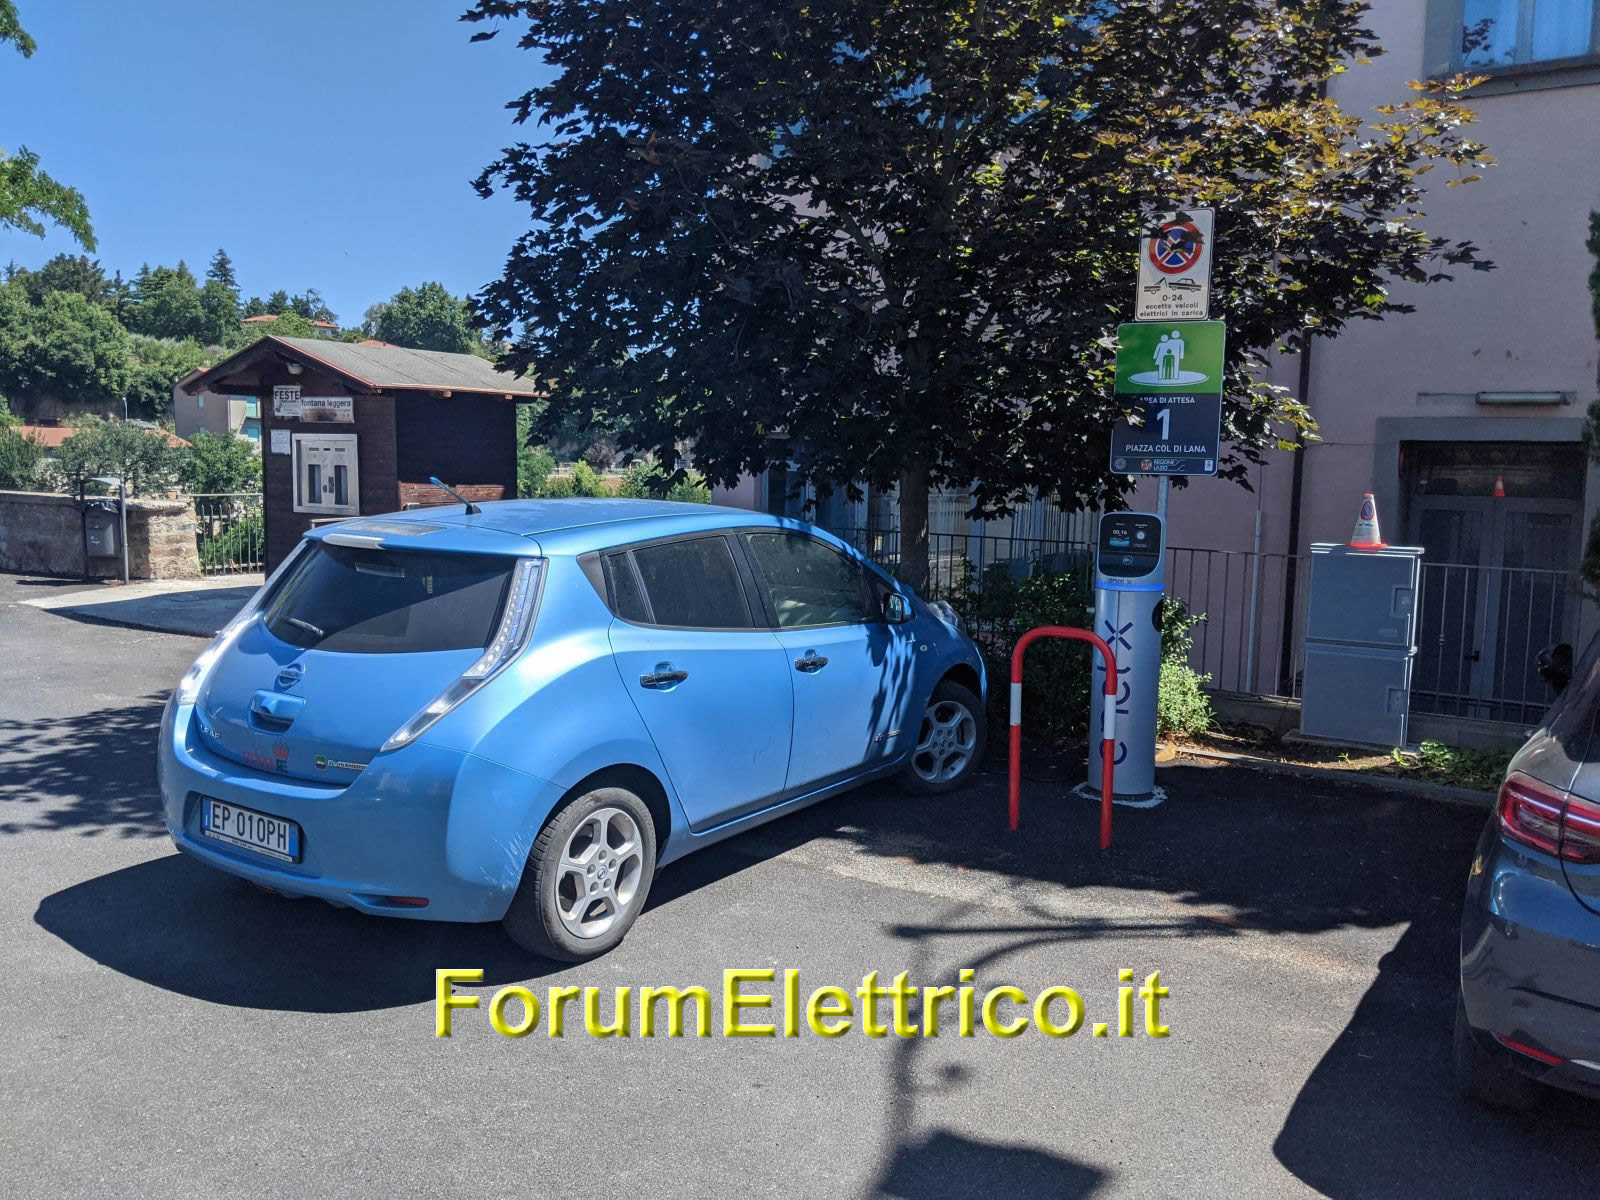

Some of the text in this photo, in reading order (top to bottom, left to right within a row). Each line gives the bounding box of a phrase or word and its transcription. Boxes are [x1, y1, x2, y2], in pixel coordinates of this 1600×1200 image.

[274, 390, 300, 400] FESTE
[1159, 396, 1167, 404] DI
[1168, 396, 1195, 404] ATTESA
[301, 399, 326, 407] fontana
[327, 399, 351, 409] leggera
[1156, 408, 1171, 440] 1
[1125, 444, 1154, 452] PIAZZA
[1183, 445, 1207, 453] LANA
[212, 803, 287, 850] EP 010PH
